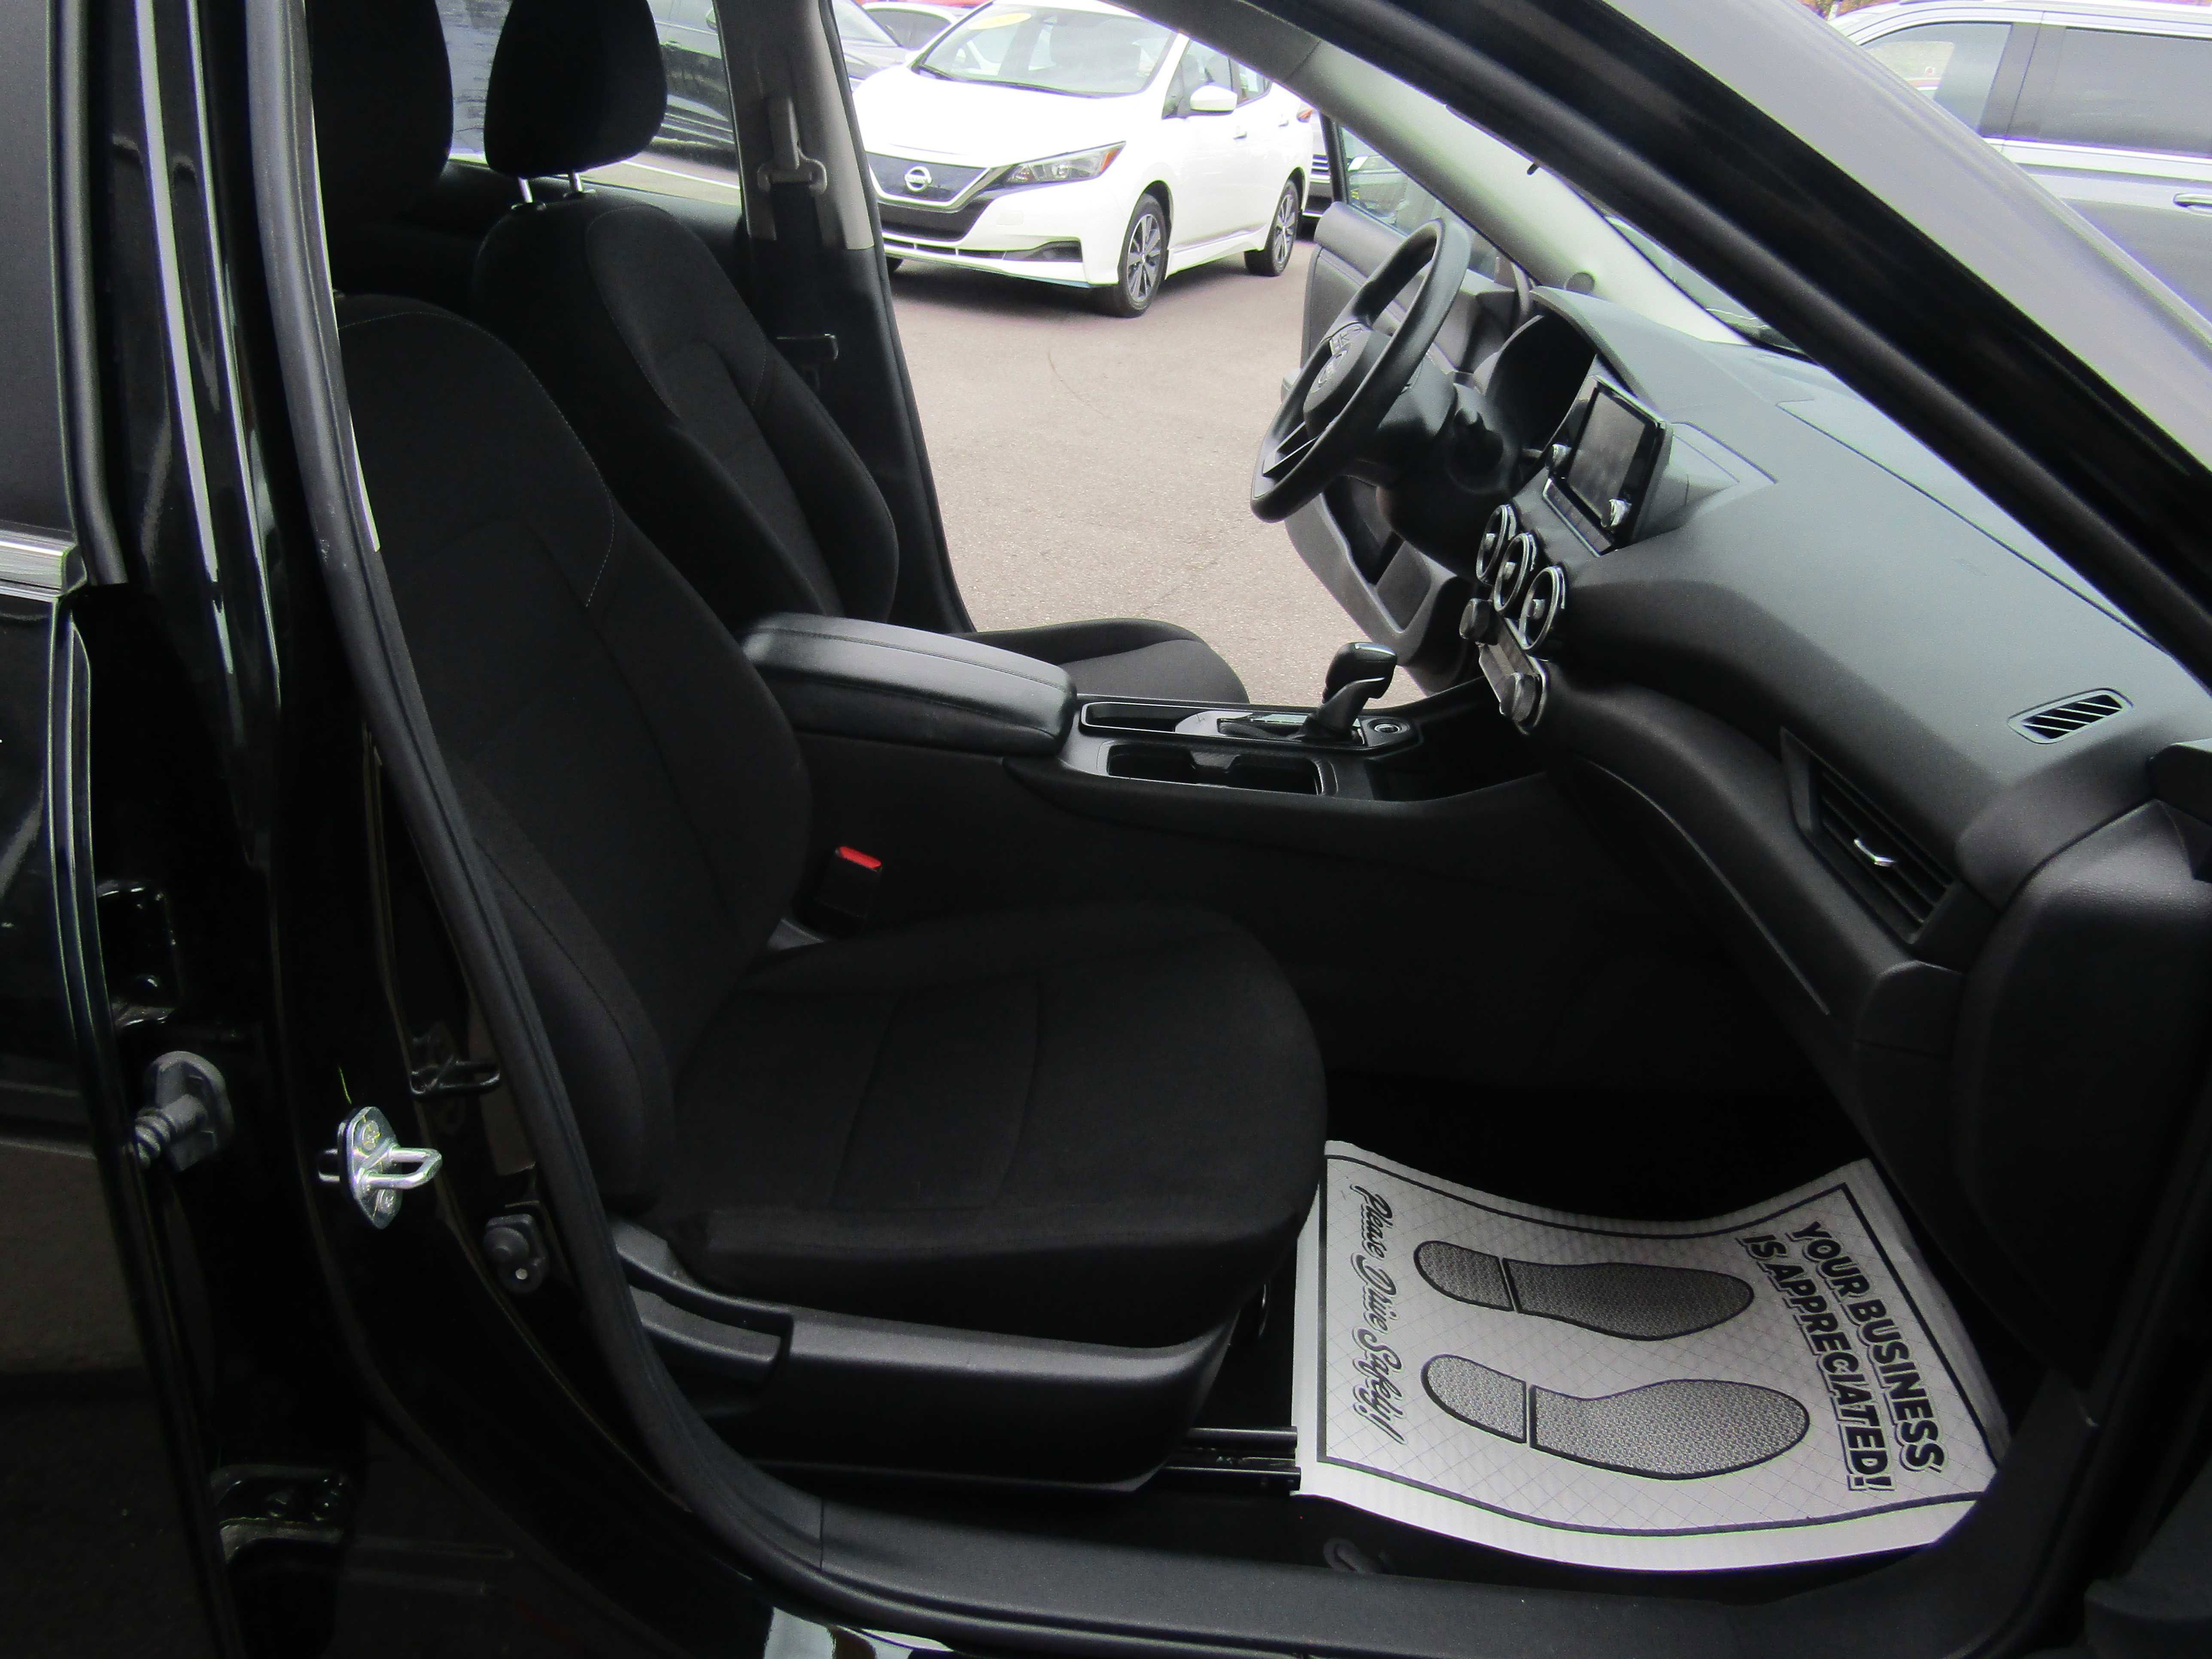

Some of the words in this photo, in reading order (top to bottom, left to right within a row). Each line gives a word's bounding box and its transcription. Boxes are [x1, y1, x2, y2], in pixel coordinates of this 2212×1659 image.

[1352, 1185, 1393, 1259] Please
[1740, 1235, 1787, 1258] IS
[1353, 1254, 1397, 1331] Drive
[1355, 1328, 1405, 1442] Safely!
[1760, 1263, 1893, 1487] APPRECIATED!
[1790, 1221, 1870, 1297] YOUR
[1847, 1299, 1945, 1468] BUSINESS
